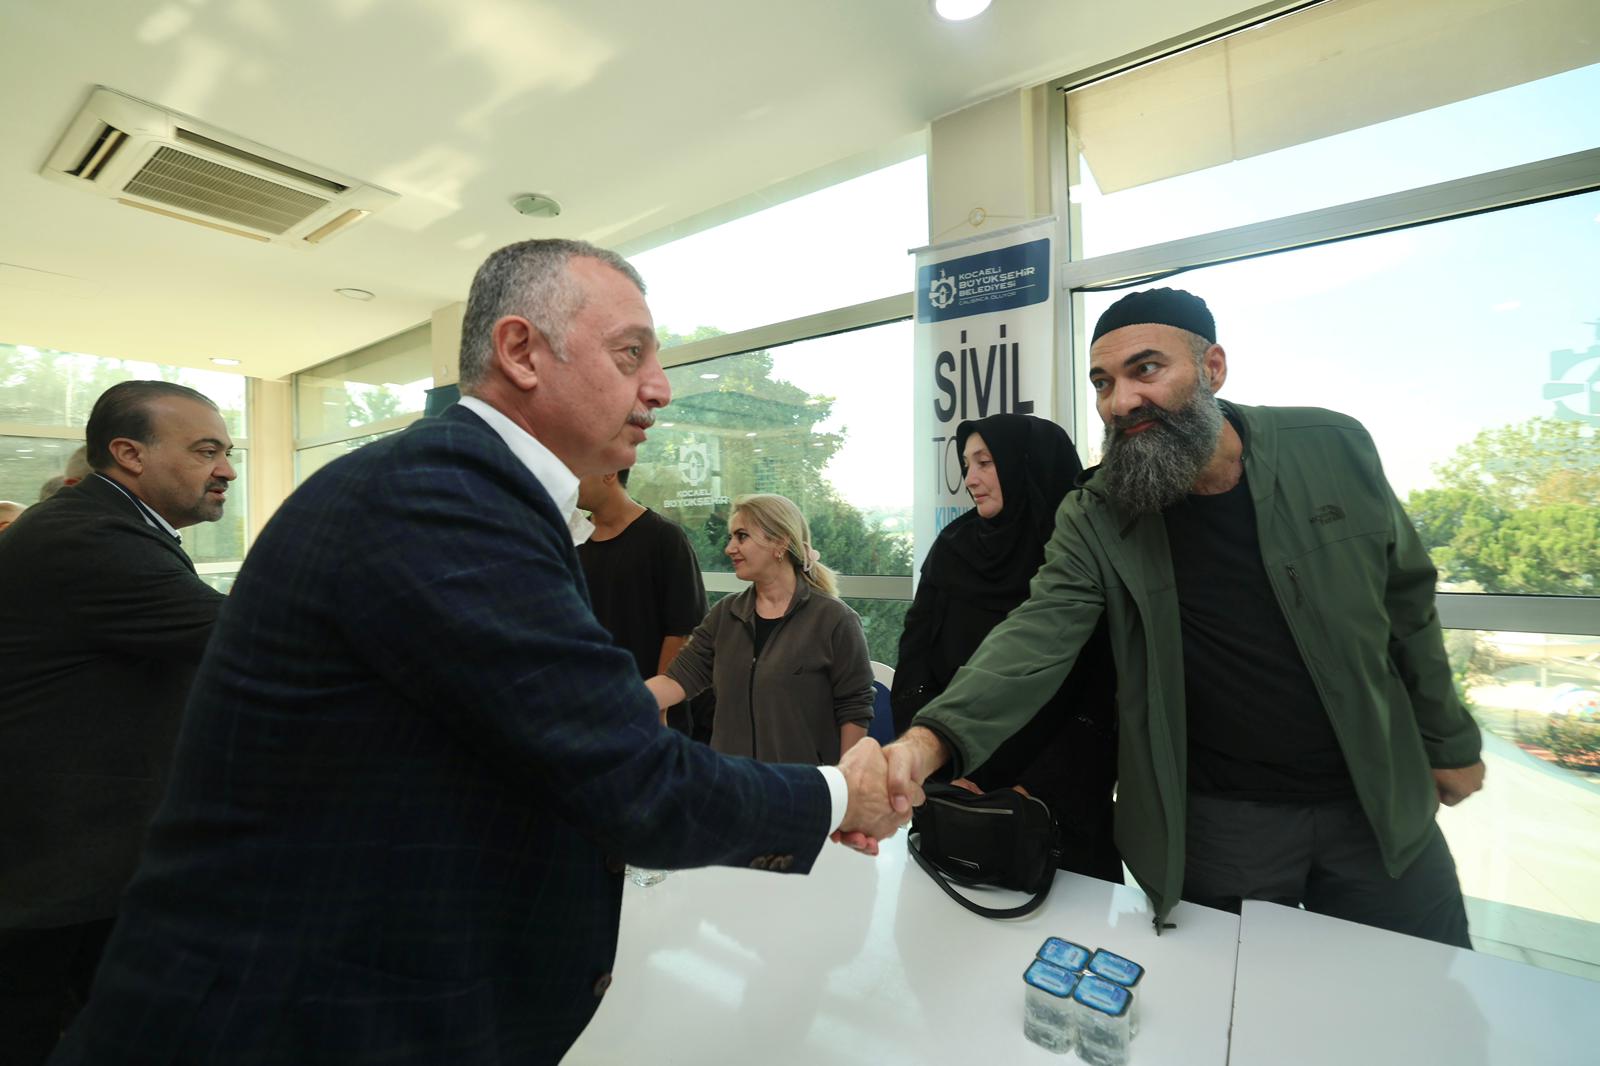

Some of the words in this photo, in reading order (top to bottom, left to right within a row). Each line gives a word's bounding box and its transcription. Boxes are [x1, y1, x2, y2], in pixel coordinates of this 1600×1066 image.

[959, 266, 1001, 280] KOCAELİ
[959, 266, 1036, 289] BÜYÜKŞEHİR
[959, 280, 1017, 297] BELEDİYESİ
[933, 324, 1034, 423] SİVİL
[932, 435, 968, 495] TO
